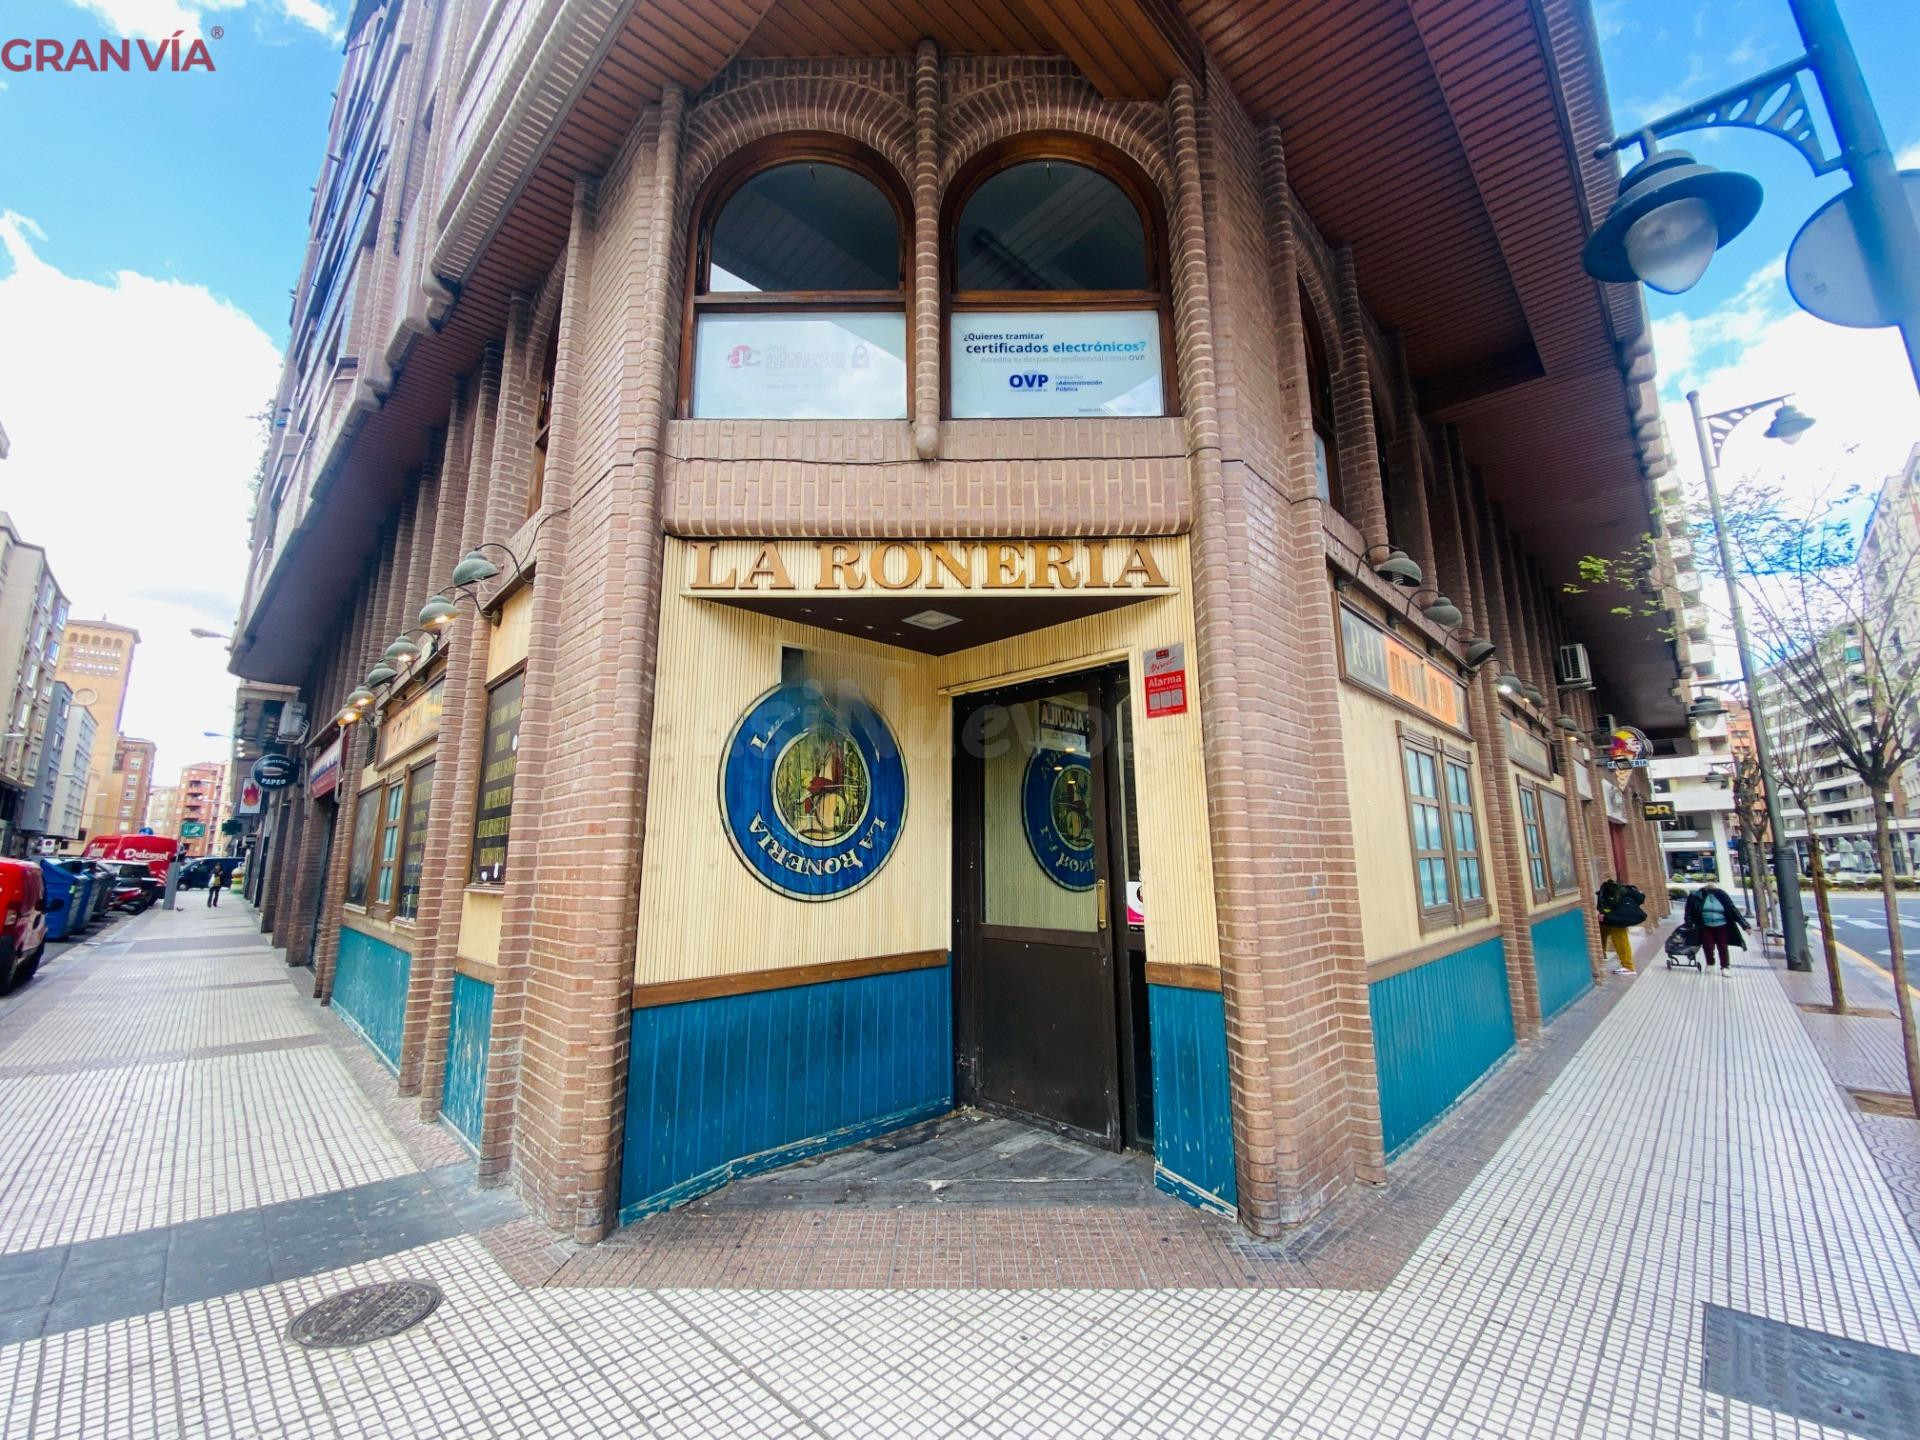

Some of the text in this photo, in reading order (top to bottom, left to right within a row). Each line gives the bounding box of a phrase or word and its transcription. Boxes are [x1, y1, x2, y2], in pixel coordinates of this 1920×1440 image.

[963, 332, 1044, 342] ¿Quieres tramitar
[966, 341, 1146, 354] certificados electrónicos?
[1061, 354, 1104, 364] profesional
[1009, 374, 1049, 389] OVP
[690, 539, 1171, 590] LA RONERIA
[1148, 674, 1182, 688] Alarma
[749, 811, 887, 876] LA RONERIA
[123, 848, 169, 860] Dulcesol
